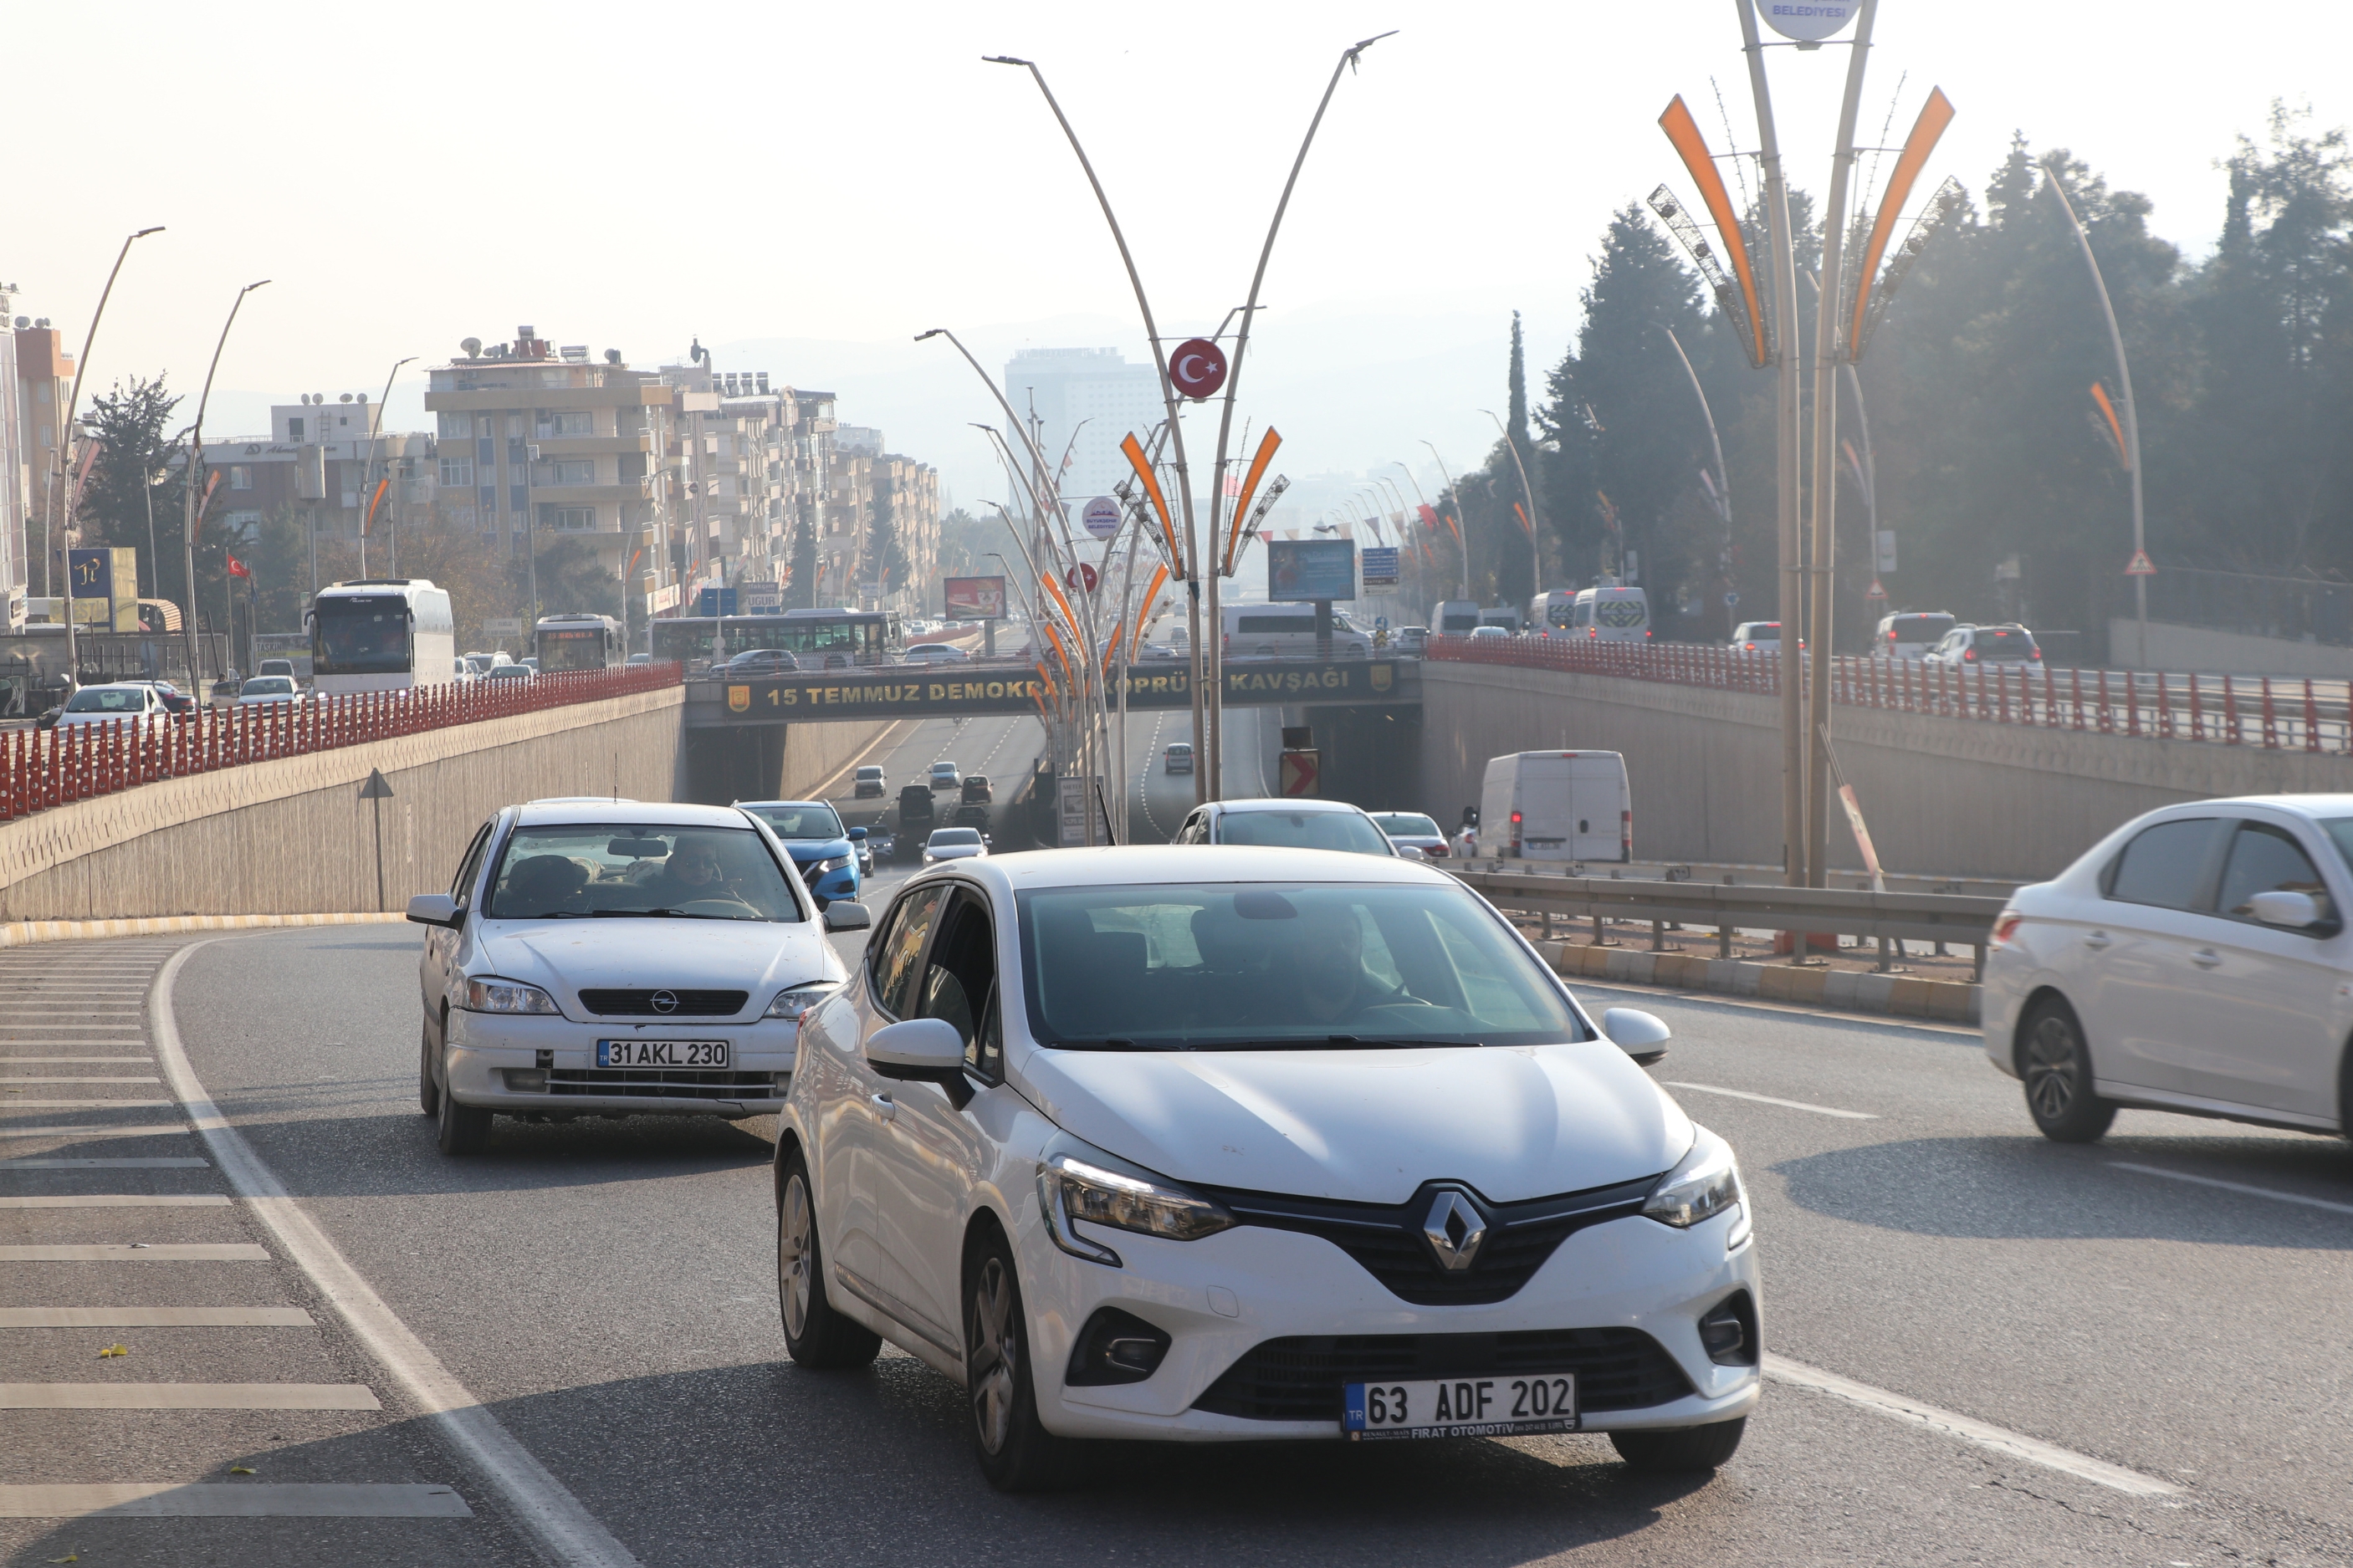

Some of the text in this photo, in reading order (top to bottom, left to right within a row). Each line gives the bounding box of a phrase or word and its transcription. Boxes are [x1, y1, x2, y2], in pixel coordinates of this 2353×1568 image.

[1772, 5, 1846, 18] BELEDİYESİ
[768, 688, 798, 706] 15
[806, 684, 920, 704] TEMMUZ
[1230, 667, 1348, 692] KAVŞAĞI
[611, 1043, 632, 1064] 31
[637, 1043, 683, 1065] AKL
[687, 1044, 726, 1065] 230
[1348, 1378, 1570, 1424] TR 63 ADF 202
[1411, 1427, 1447, 1438] FIRAT
